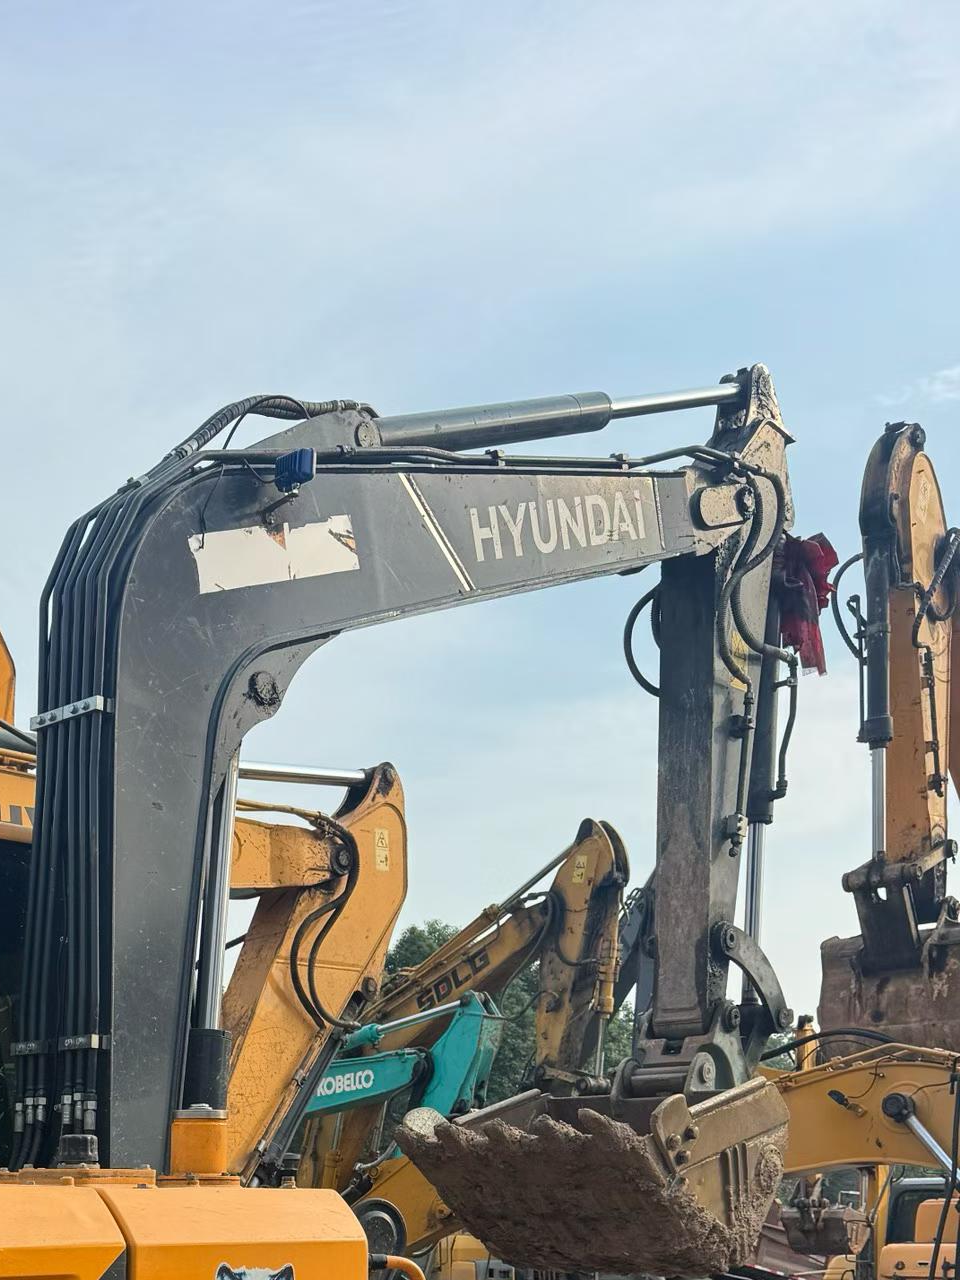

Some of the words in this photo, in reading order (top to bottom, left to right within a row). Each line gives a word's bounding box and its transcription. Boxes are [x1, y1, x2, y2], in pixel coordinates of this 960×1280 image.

[469, 489, 647, 562] HYUNDAI
[416, 947, 490, 1012] SDLG
[317, 1069, 375, 1097] KOBELCO
